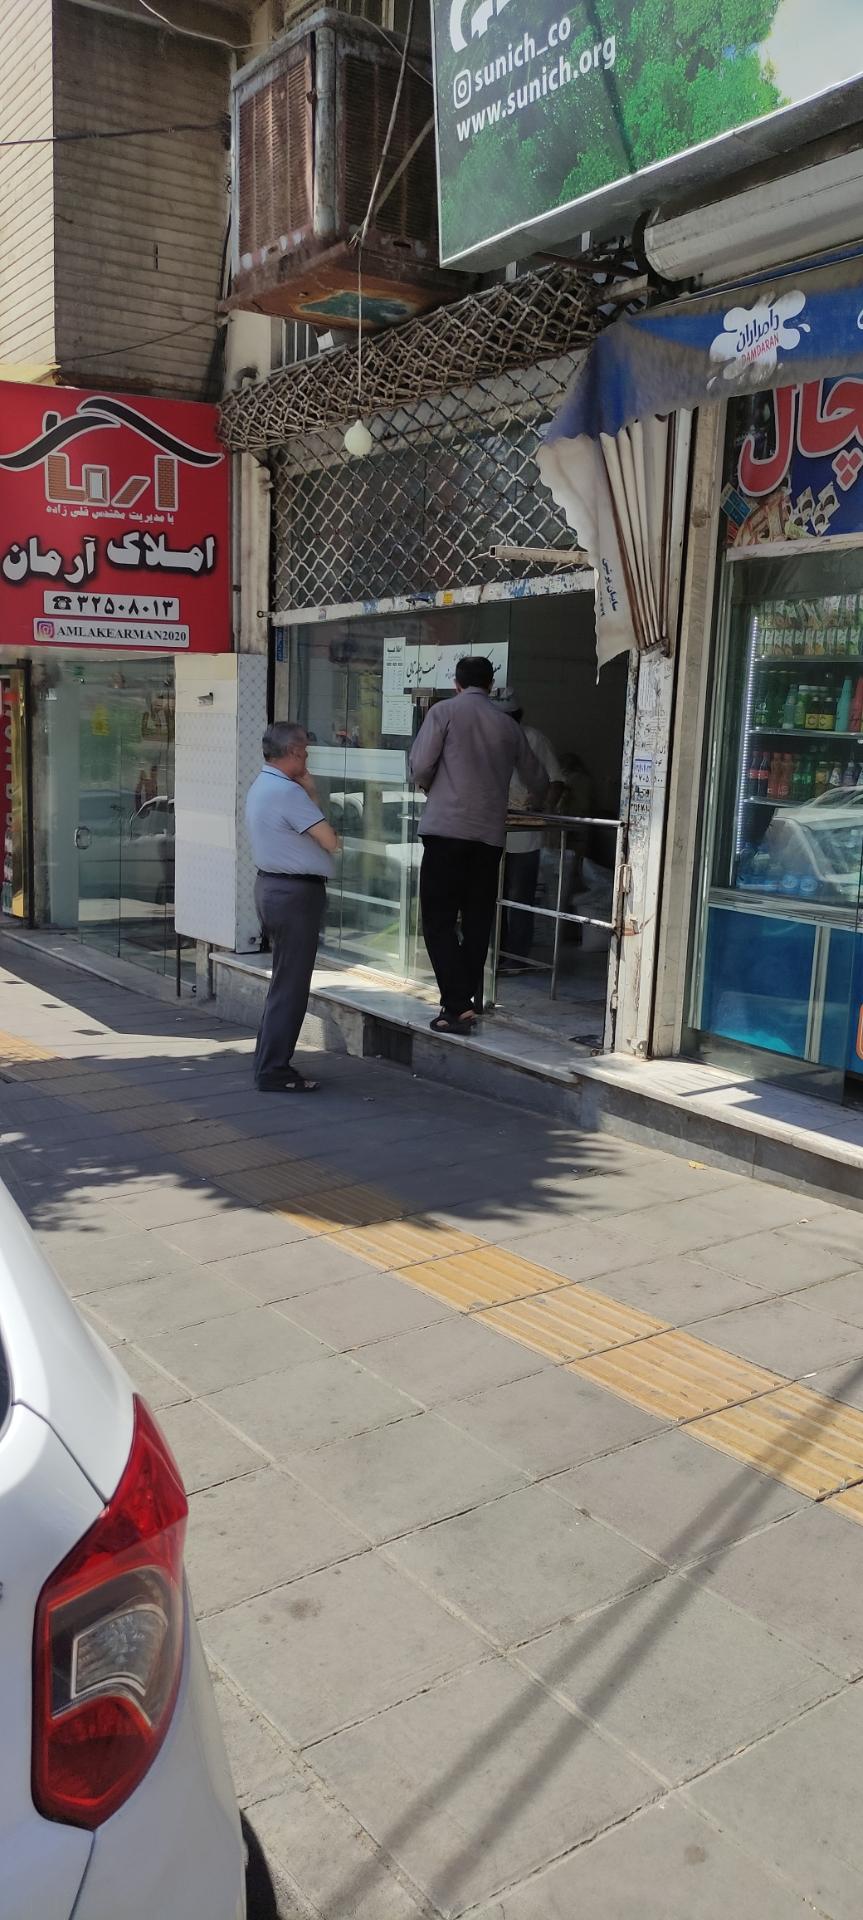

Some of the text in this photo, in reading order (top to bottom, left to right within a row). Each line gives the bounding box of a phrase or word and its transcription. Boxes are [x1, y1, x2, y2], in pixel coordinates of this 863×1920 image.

[474, 16, 572, 92] sunich_co
[456, 35, 618, 143] www.sunich.org
[741, 334, 779, 366] DAMDARAN
[92, 508, 126, 520] مهندس
[129, 510, 165, 524] مدیریت
[167, 512, 175, 525] با
[2, 531, 215, 584] املاک آرمان
[76, 596, 173, 618] ۳۲۵۰۸۰۱۳
[57, 625, 187, 643] AMLAKEARMAN2020
